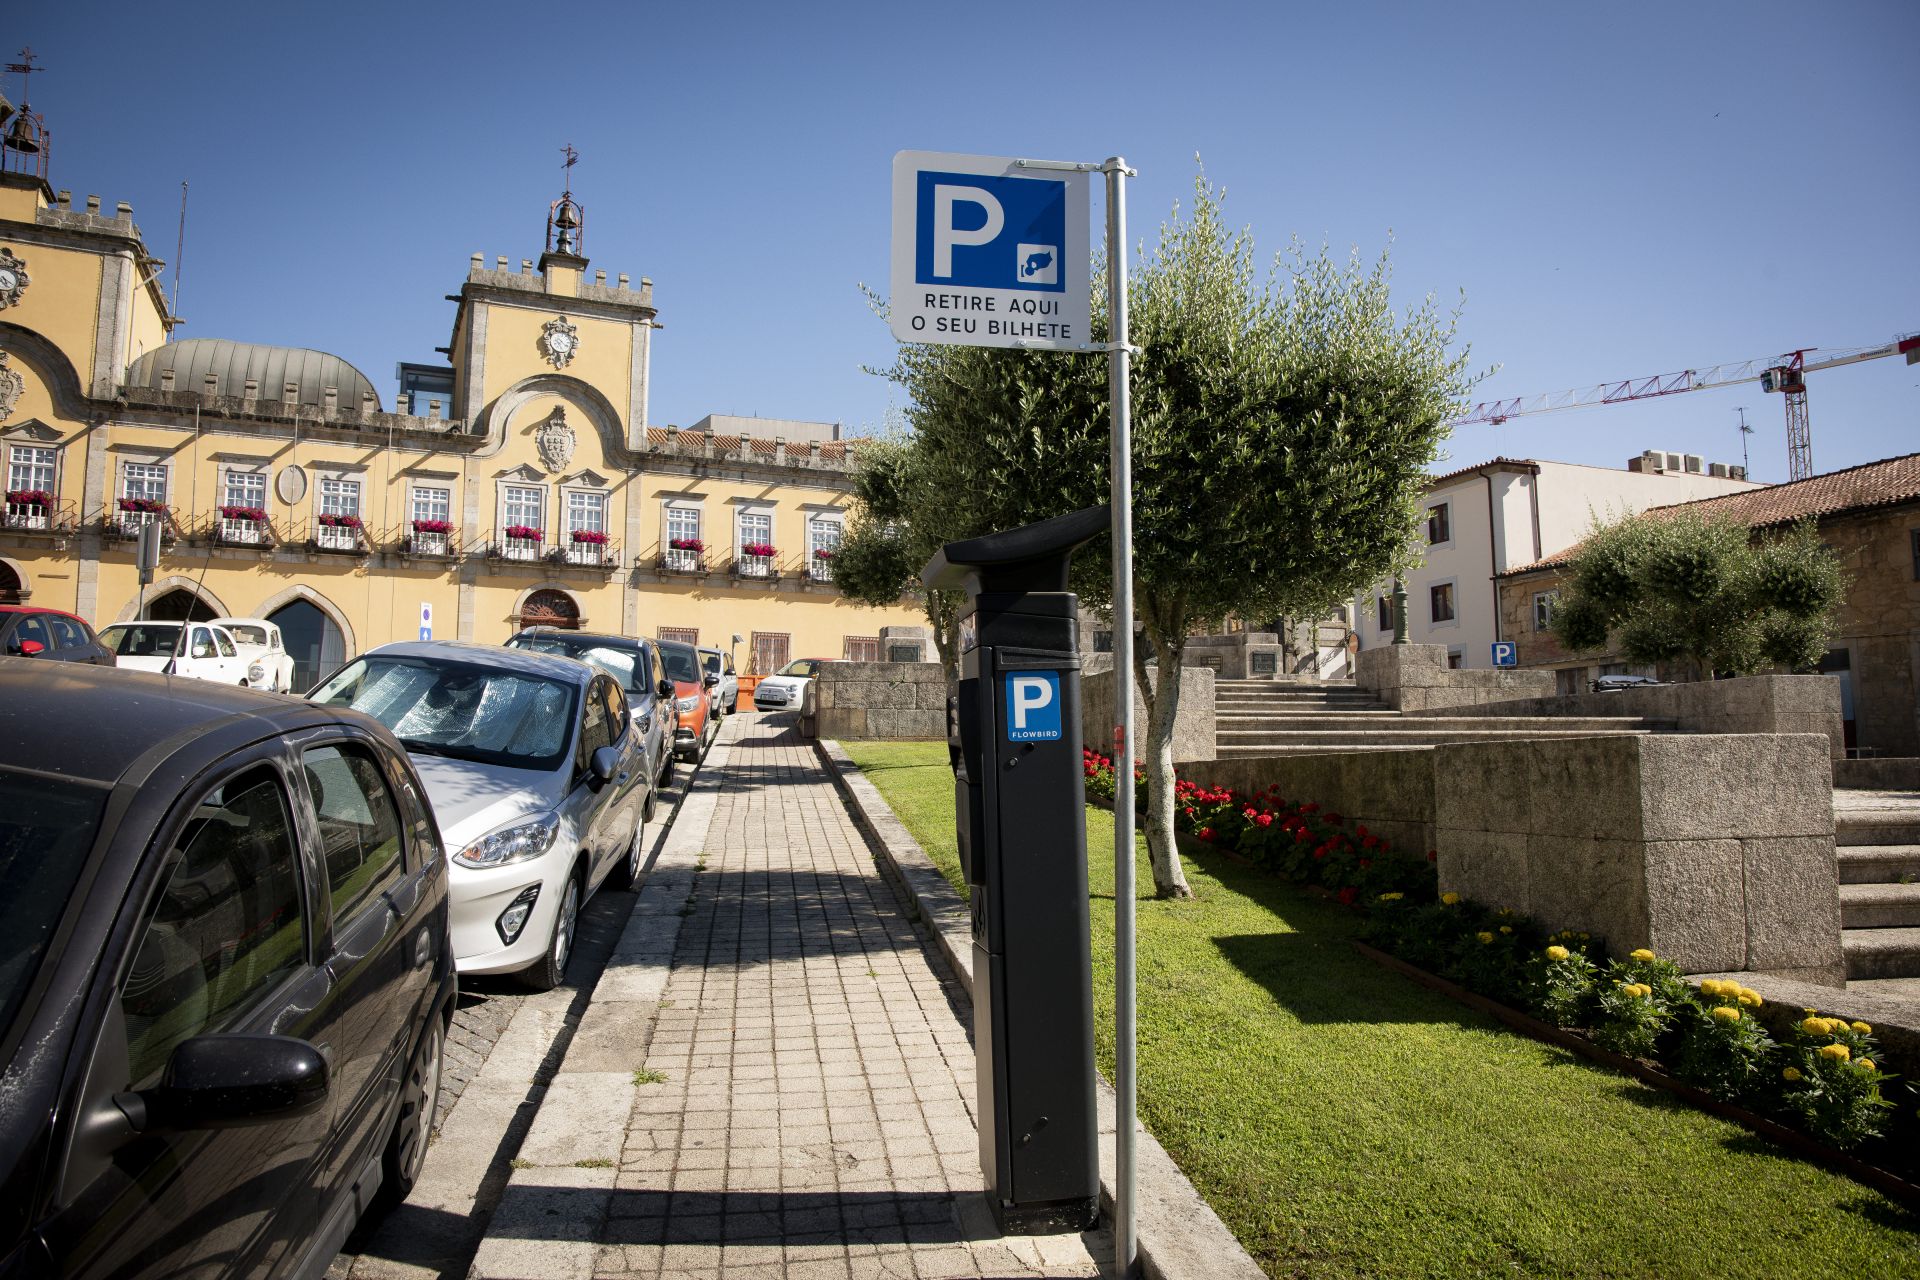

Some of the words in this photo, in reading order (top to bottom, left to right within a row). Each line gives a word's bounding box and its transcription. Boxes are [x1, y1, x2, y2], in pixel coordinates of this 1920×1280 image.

[933, 184, 1005, 278] P
[925, 293, 996, 312] RETIRE
[1009, 298, 1058, 316] AQUI
[911, 315, 926, 331] O
[936, 316, 976, 333] SEU
[988, 320, 1071, 339] BILHETE
[1496, 645, 1510, 664] P
[1013, 677, 1052, 728] P
